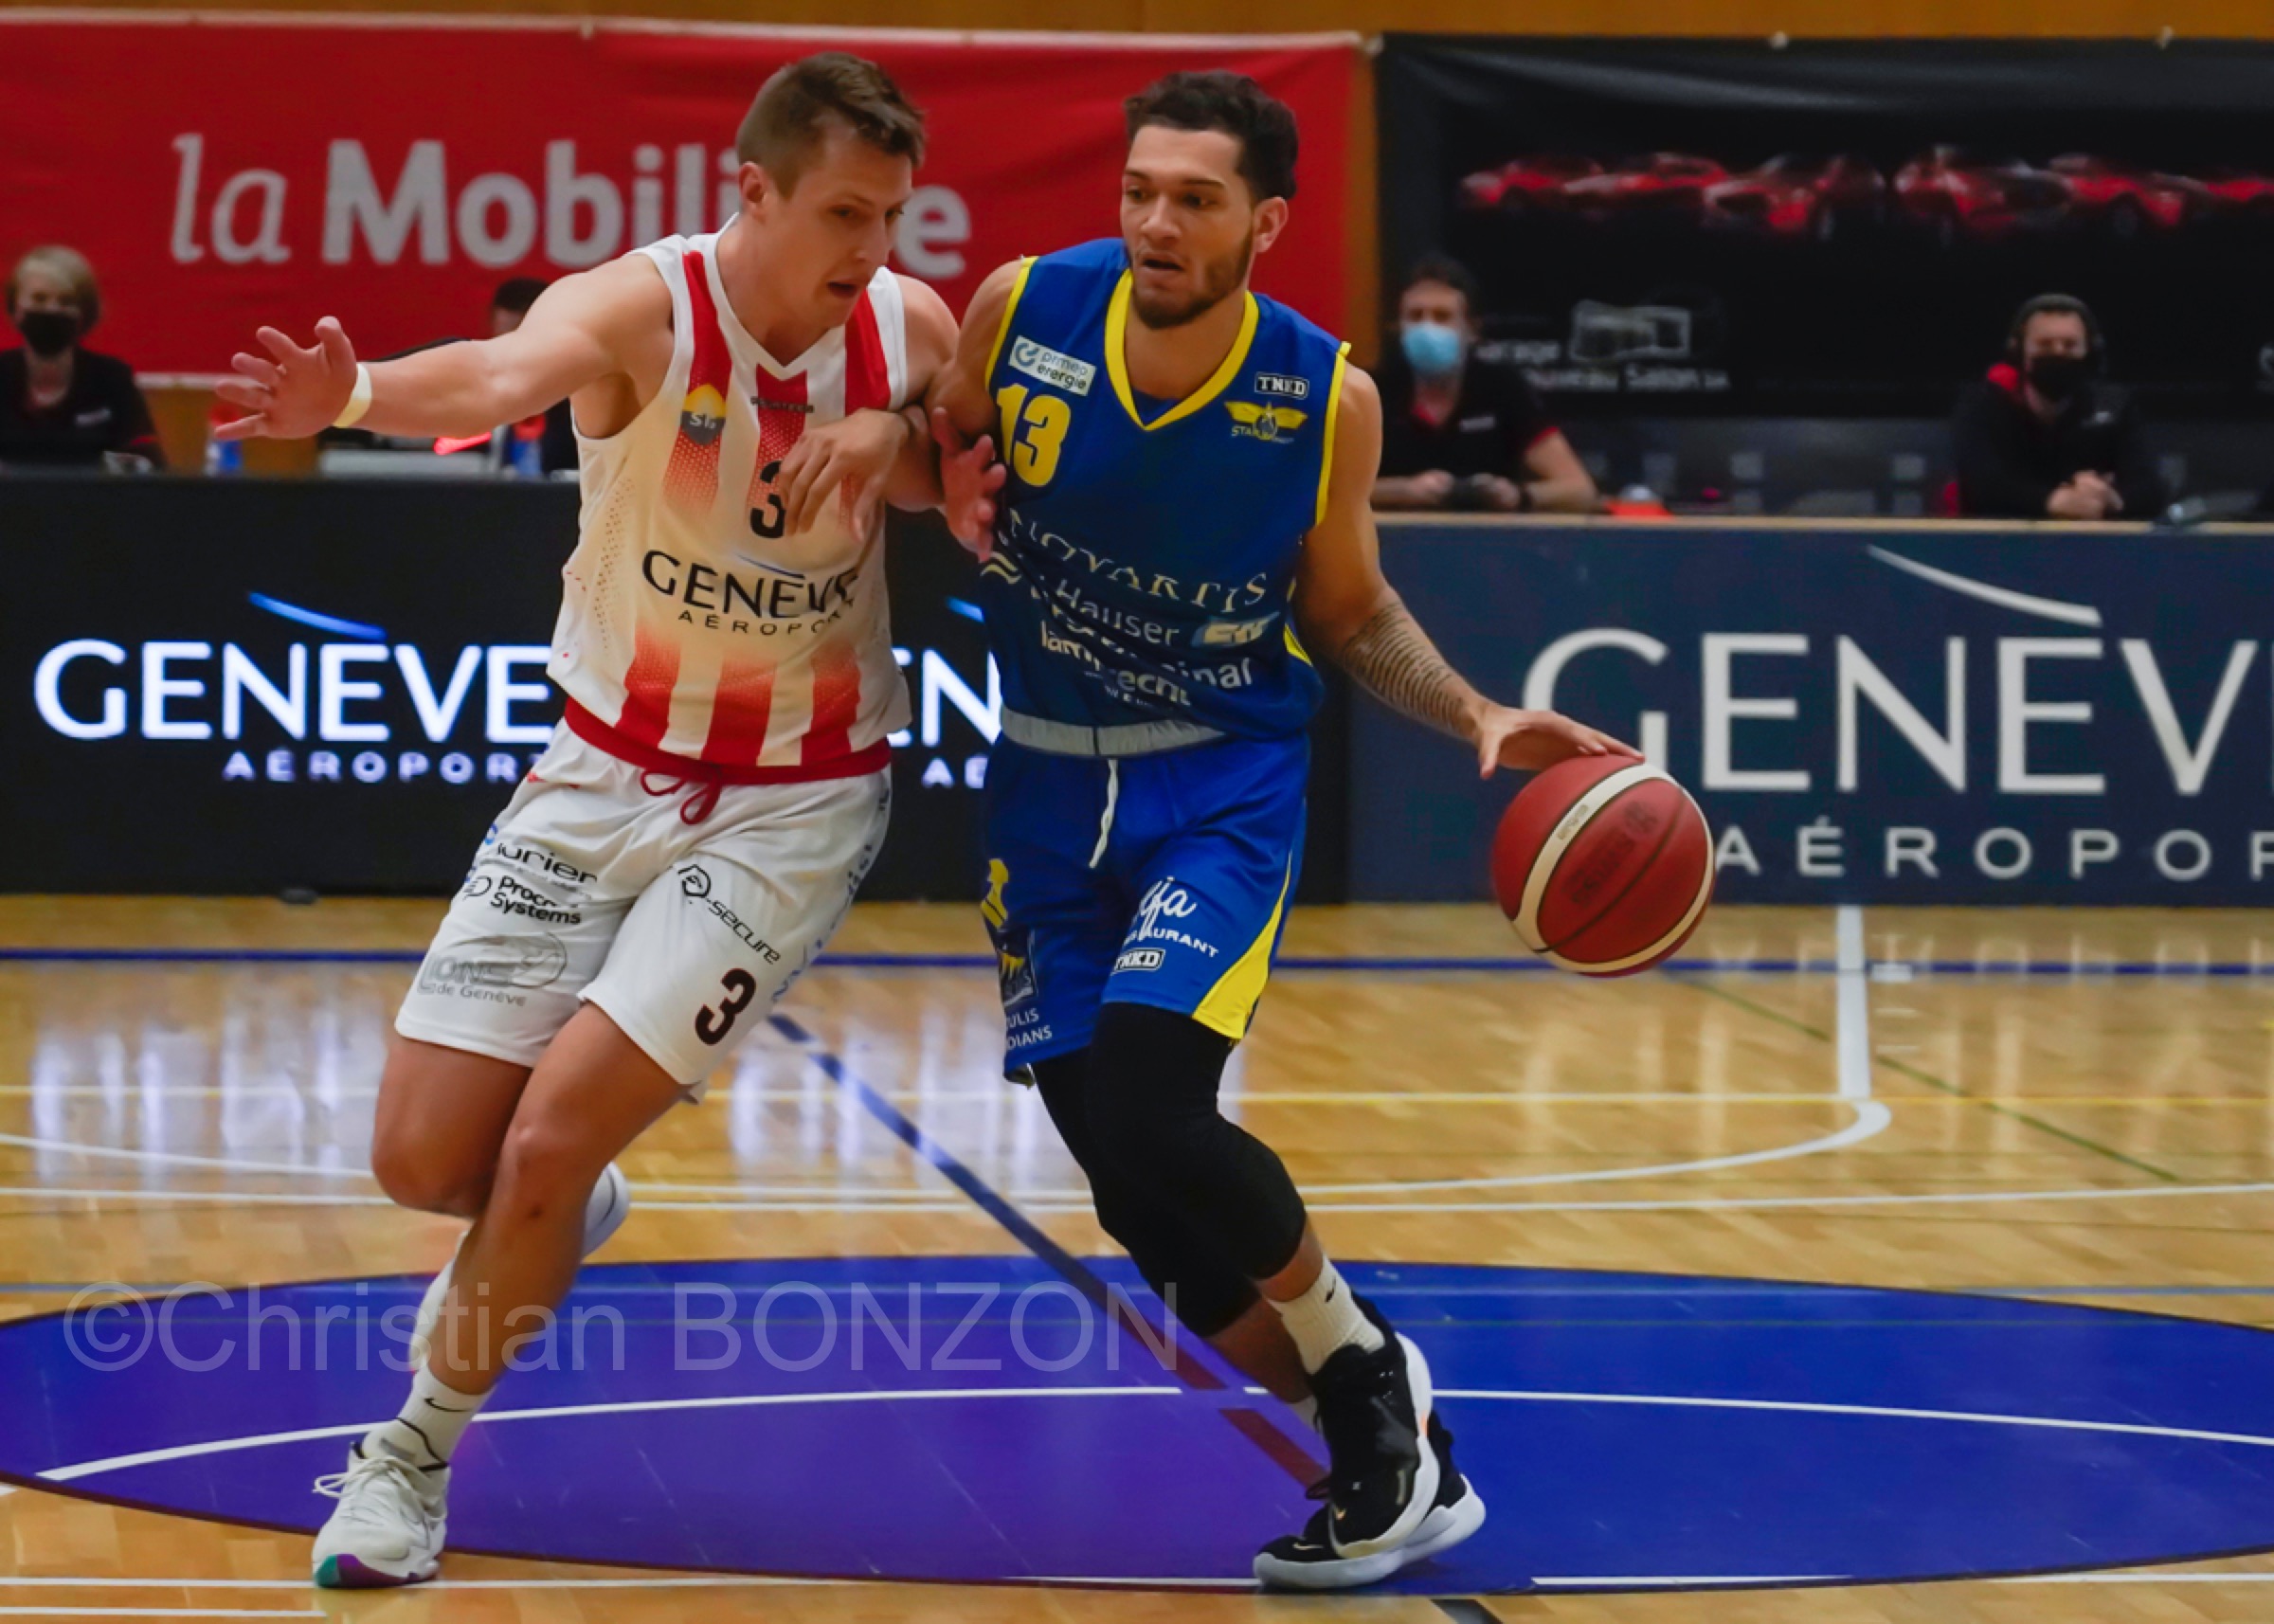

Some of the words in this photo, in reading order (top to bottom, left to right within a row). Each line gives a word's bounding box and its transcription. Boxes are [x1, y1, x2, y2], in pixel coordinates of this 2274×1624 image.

[169, 133, 291, 265] la
[321, 138, 971, 279] Mobilie
[996, 382, 1072, 487] 13
[1522, 546, 2274, 795] GENÈV
[223, 744, 546, 784] AÉROPOR
[490, 892, 582, 925] Systems
[695, 967, 757, 1047] 3
